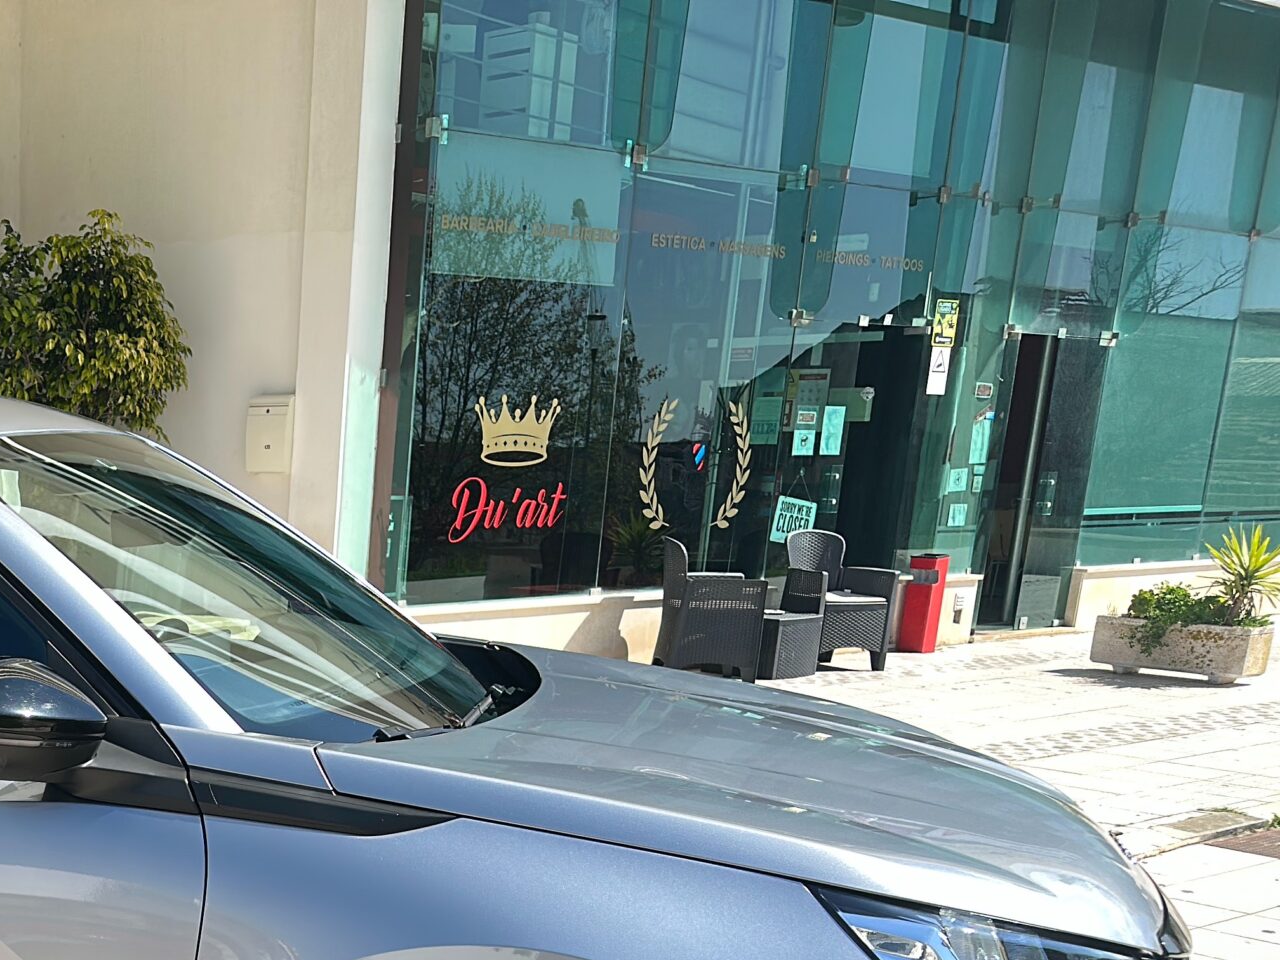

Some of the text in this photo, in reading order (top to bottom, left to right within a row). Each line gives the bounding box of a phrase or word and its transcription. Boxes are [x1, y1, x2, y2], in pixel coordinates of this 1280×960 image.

[880, 255, 924, 272] TATTOOS
[448, 476, 567, 543] Du'art
[779, 500, 813, 517] SORRY WE'RE
[775, 512, 810, 534] CLOSED
